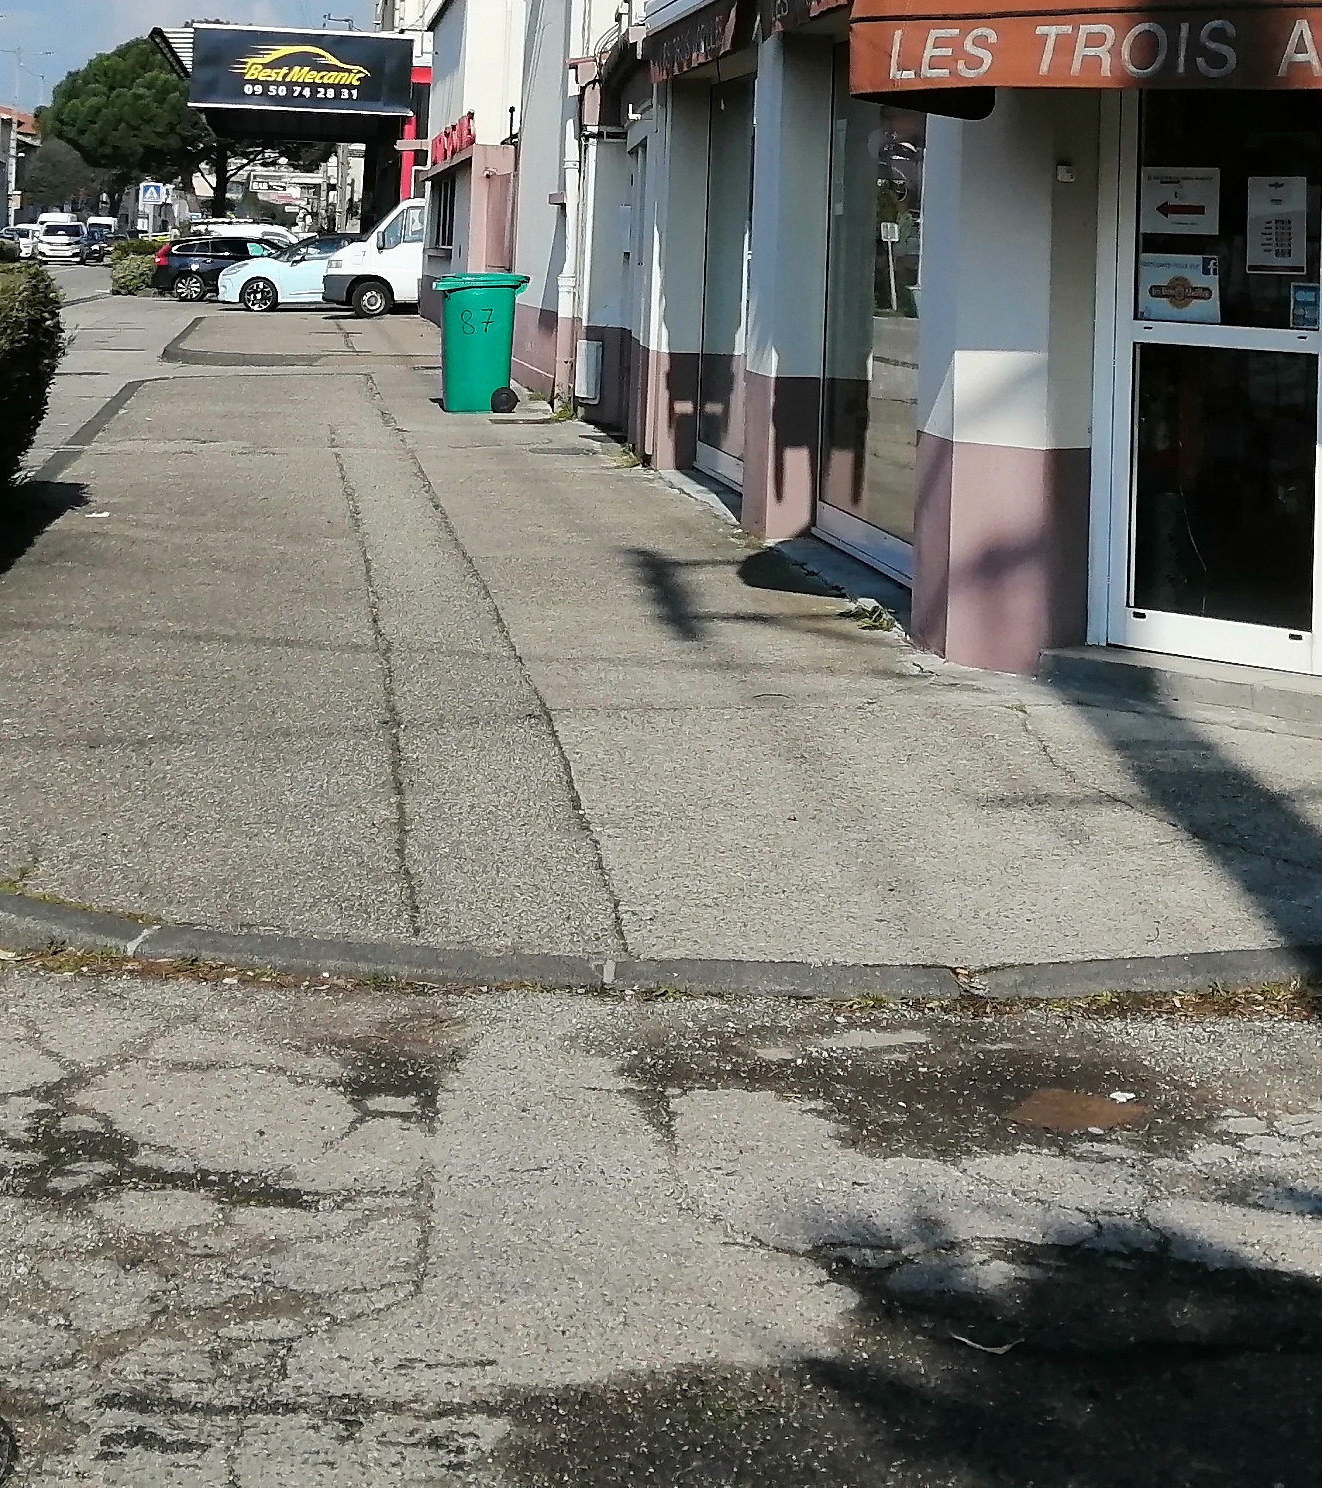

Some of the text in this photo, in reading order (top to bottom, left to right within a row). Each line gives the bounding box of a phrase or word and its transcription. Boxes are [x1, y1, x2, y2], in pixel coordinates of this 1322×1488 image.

[890, 27, 998, 81] LES
[1035, 19, 1239, 78] TROIS
[244, 65, 363, 86] Best Mecanic
[244, 84, 358, 99] 09 50 74 28 31
[460, 308, 494, 335] 87
